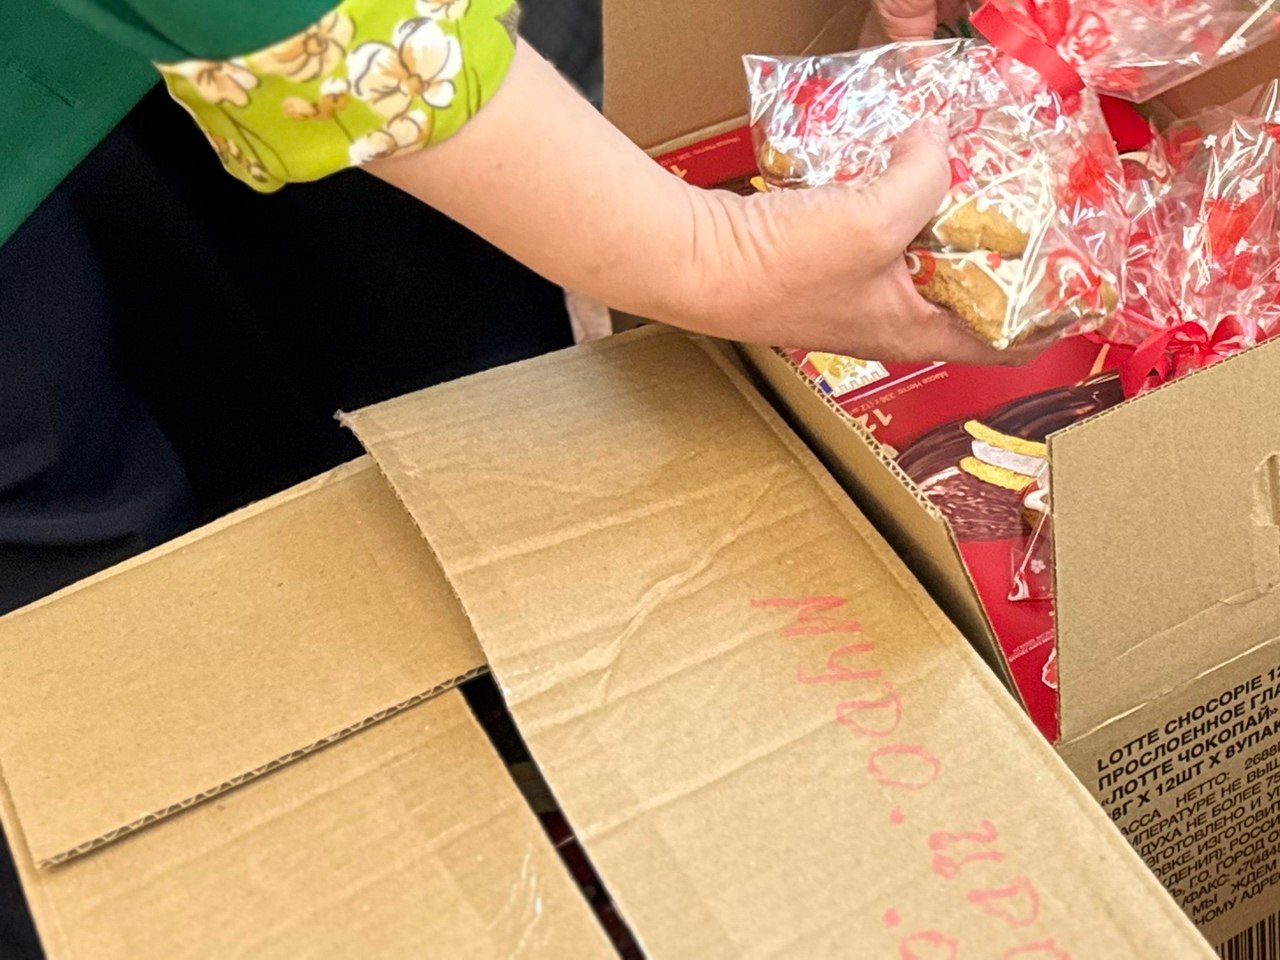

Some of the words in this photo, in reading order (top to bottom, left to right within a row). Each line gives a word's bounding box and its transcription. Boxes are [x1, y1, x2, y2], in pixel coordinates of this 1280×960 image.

[1097, 727, 1159, 772] LOTTE
[1164, 673, 1262, 737] CHOCOPIE
[1099, 700, 1245, 791] ПРОСЛОЕННОЕ
[1101, 757, 1173, 809] «ЛОТТЕ
[1178, 699, 1278, 766] ЧОКОПАЙ»
[1108, 799, 1132, 824] 8Г
[1156, 759, 1204, 797] 12ШТ
[1120, 805, 1161, 839] АССА
[1176, 768, 1230, 809] НЕТТО:
[1186, 810, 1206, 832] НЕ
[1212, 781, 1261, 819] БОЛЕЕ
[1220, 777, 1240, 798] НЕ
[1147, 804, 1244, 869] ЗГОТОВЛЕНО
[1251, 795, 1260, 811] И
[1216, 836, 1264, 873] ГОРОД
[1192, 892, 1216, 917] МЫ
[1230, 858, 1276, 895] ЖДЕМ
